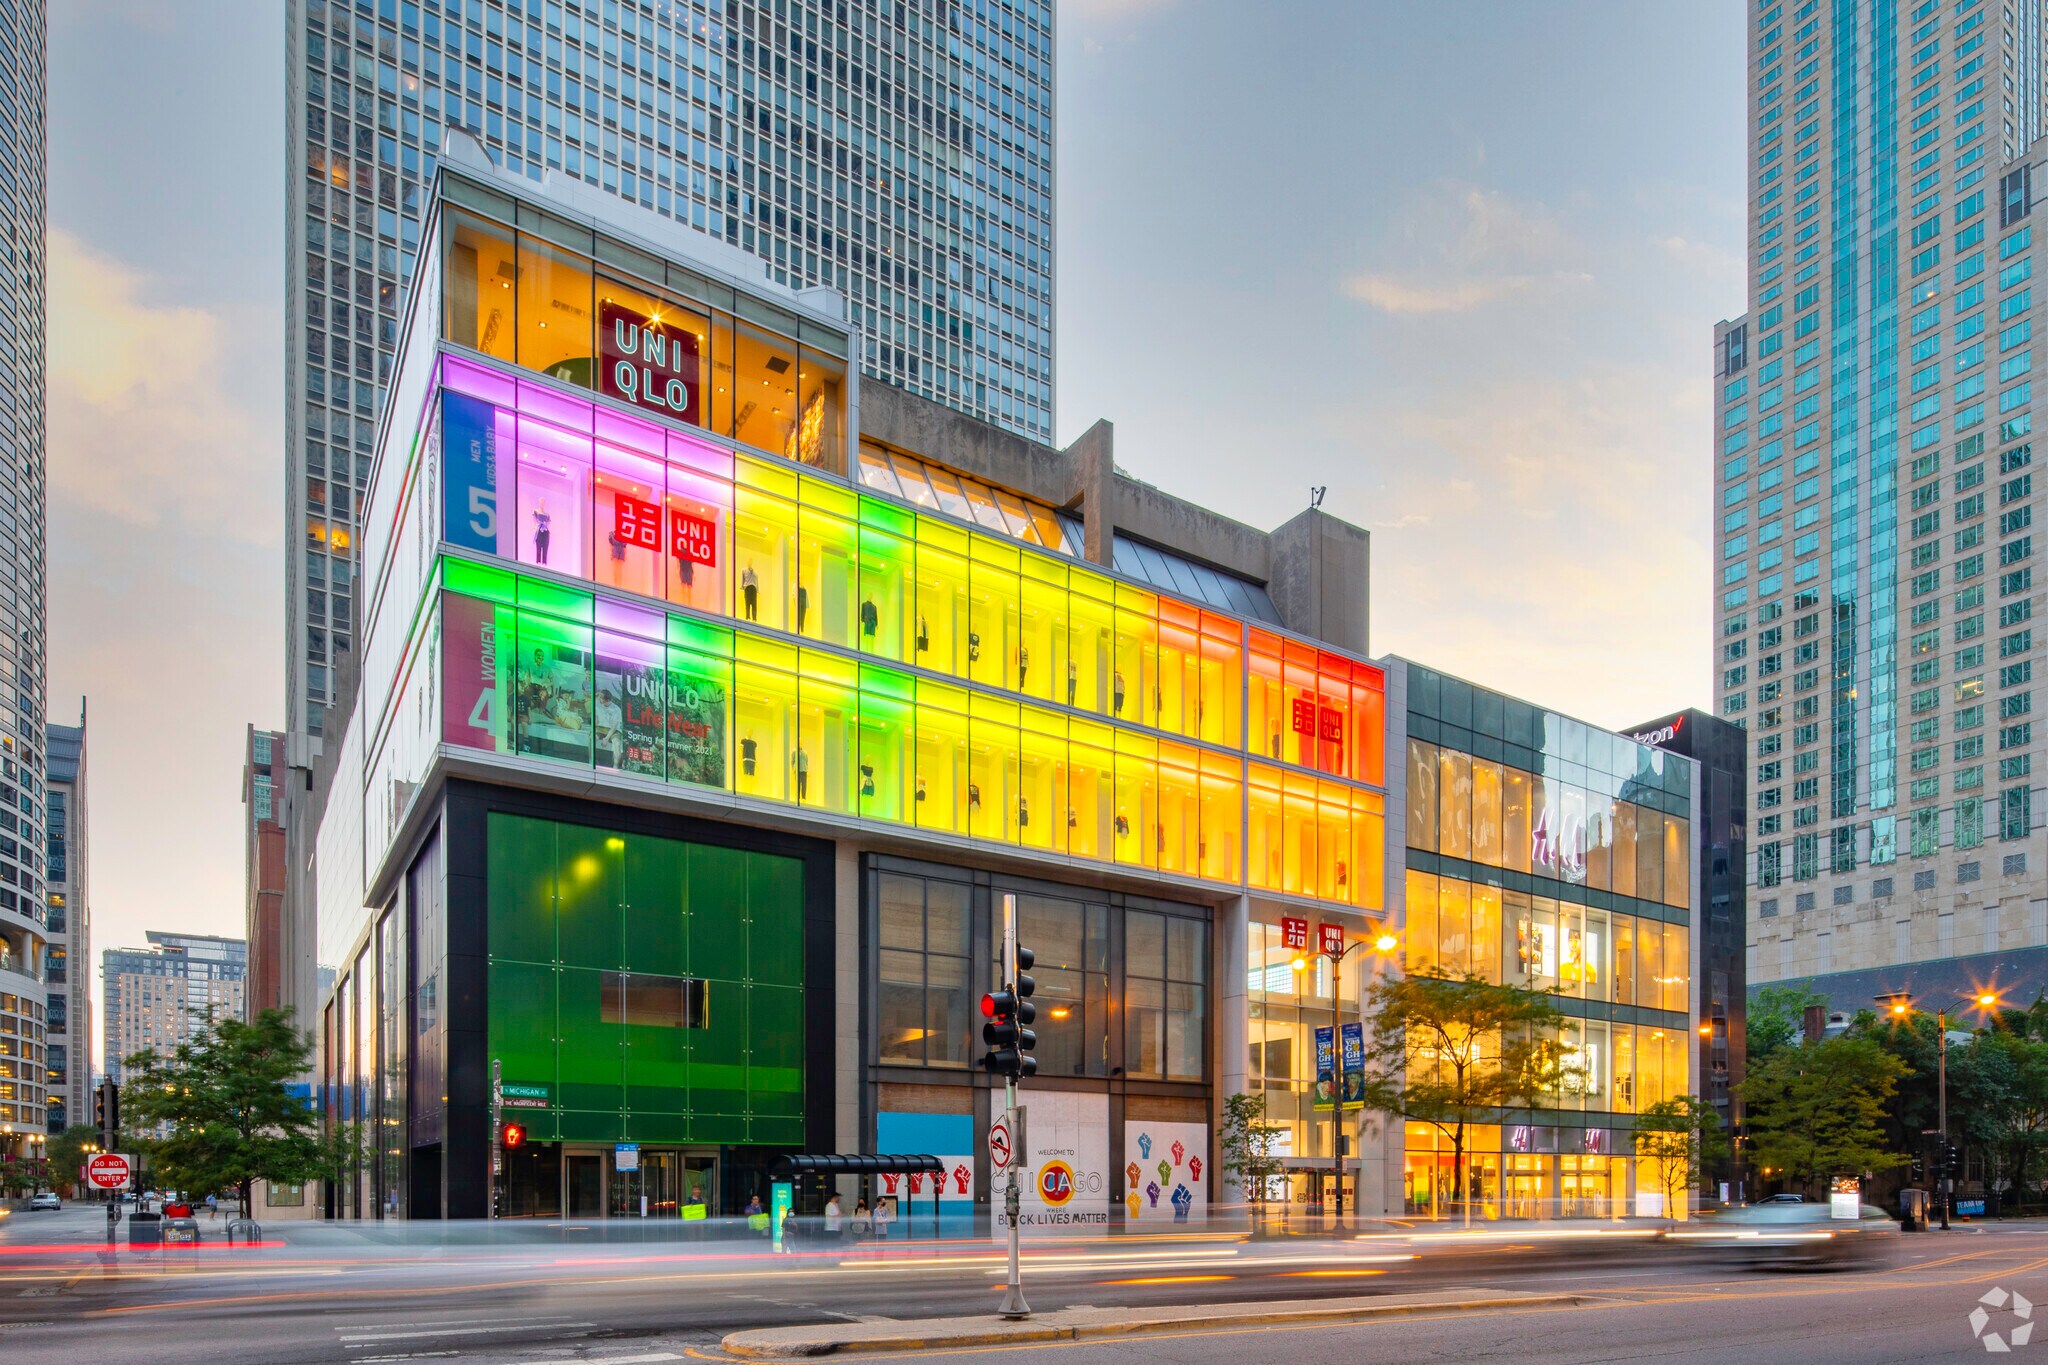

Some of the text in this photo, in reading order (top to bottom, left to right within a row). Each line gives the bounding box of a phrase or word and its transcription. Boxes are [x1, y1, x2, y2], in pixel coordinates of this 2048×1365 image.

[616, 318, 681, 373] UNI
[615, 360, 688, 412] QLO
[471, 440, 481, 463] MEN
[469, 485, 497, 538] 5
[677, 518, 708, 542] UNI
[676, 537, 711, 560] QLO
[481, 621, 496, 681] WOMEN
[626, 675, 699, 710] UNIQLO
[468, 687, 496, 737] 4
[1323, 711, 1339, 727] UNI
[627, 731, 653, 744] Spring
[695, 744, 712, 755] 2021
[1323, 725, 1341, 739] QLO
[1326, 927, 1341, 940] UNI
[998, 1213, 1107, 1225] BLCK LIVES MATTER
